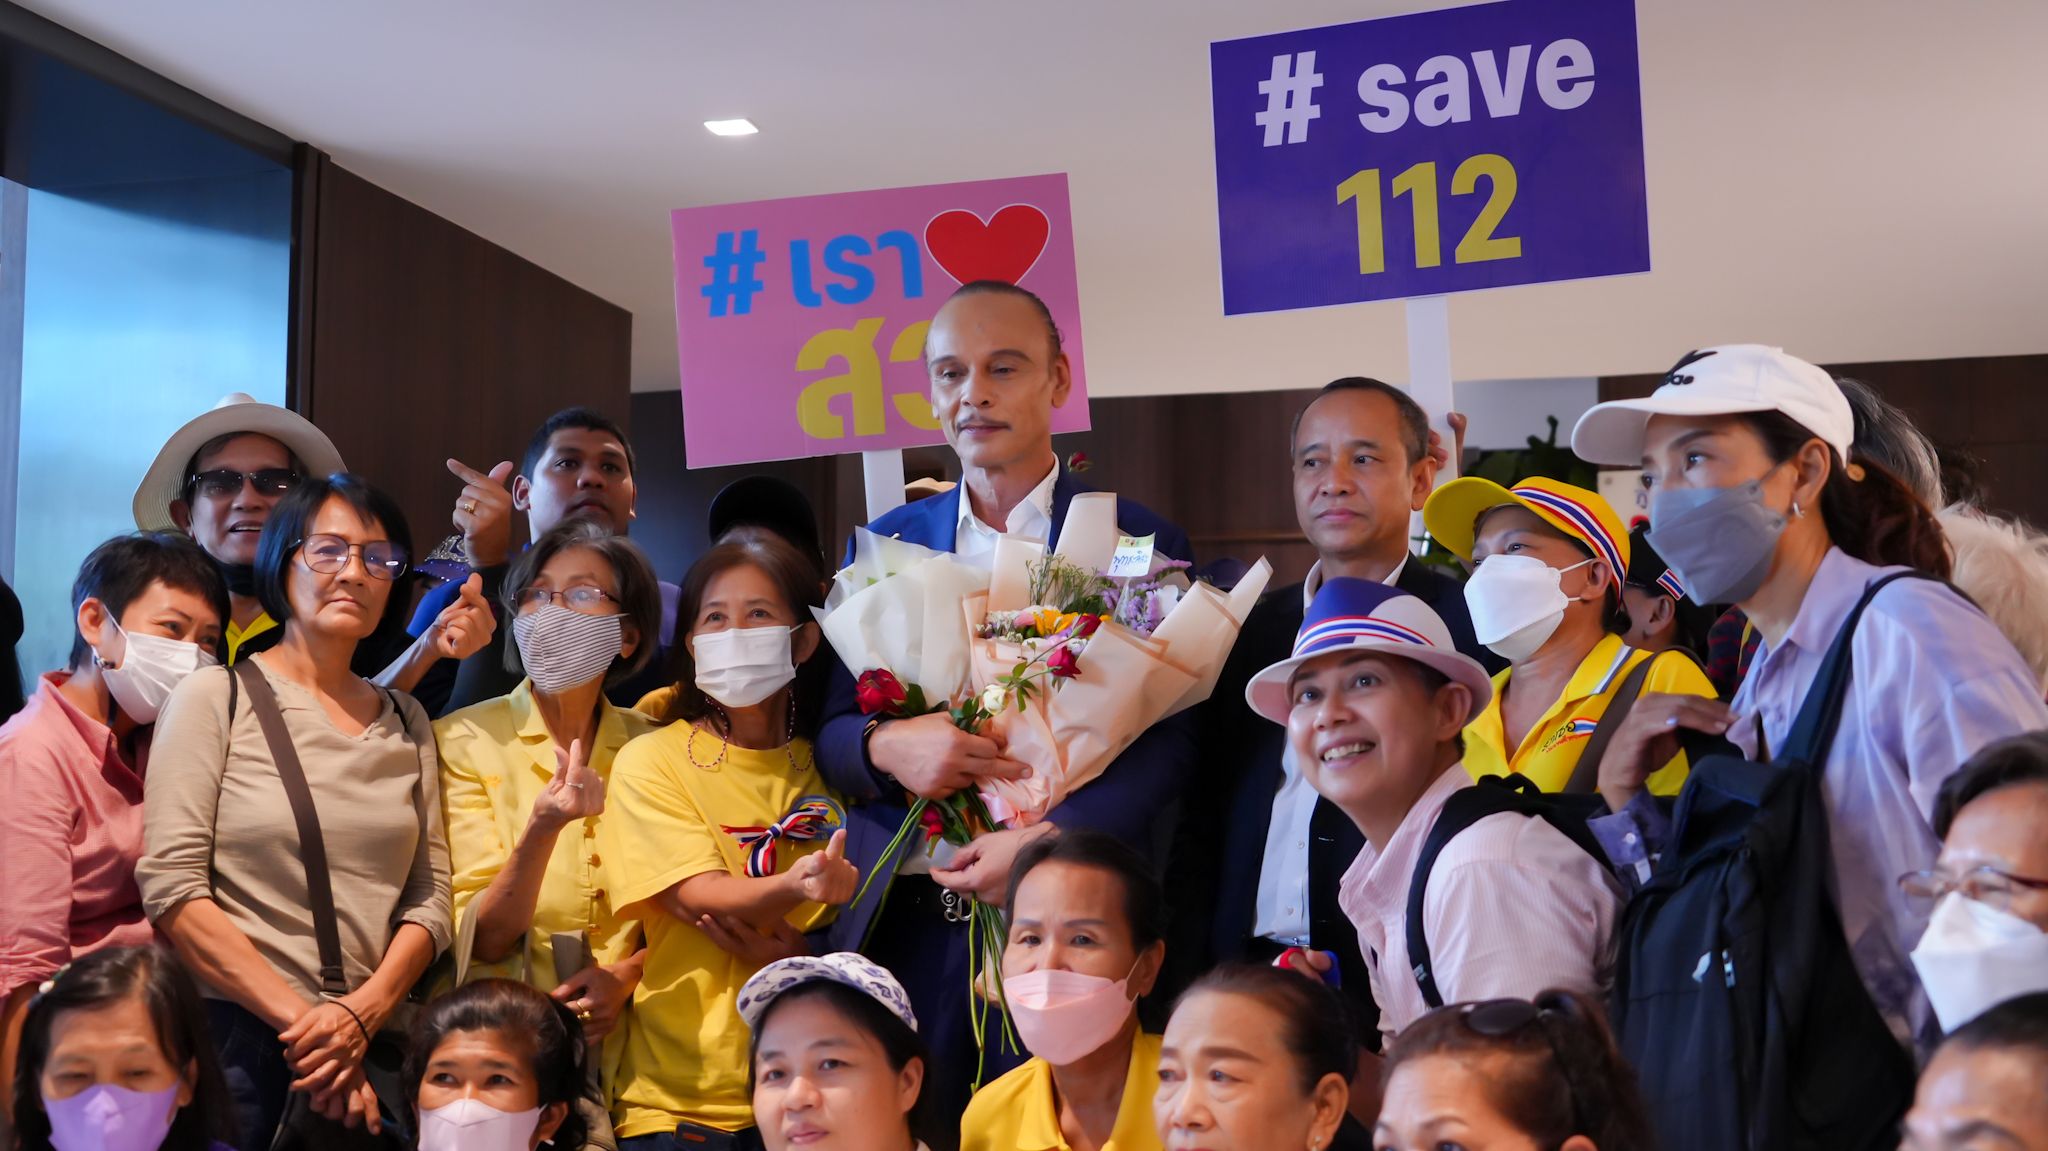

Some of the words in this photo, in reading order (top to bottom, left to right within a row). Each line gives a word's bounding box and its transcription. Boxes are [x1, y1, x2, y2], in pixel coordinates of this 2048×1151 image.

[1255, 50, 1324, 147] #
[1357, 38, 1596, 133] save
[1336, 153, 1522, 275] 112
[701, 229, 766, 317] #
[789, 230, 923, 307] เรา
